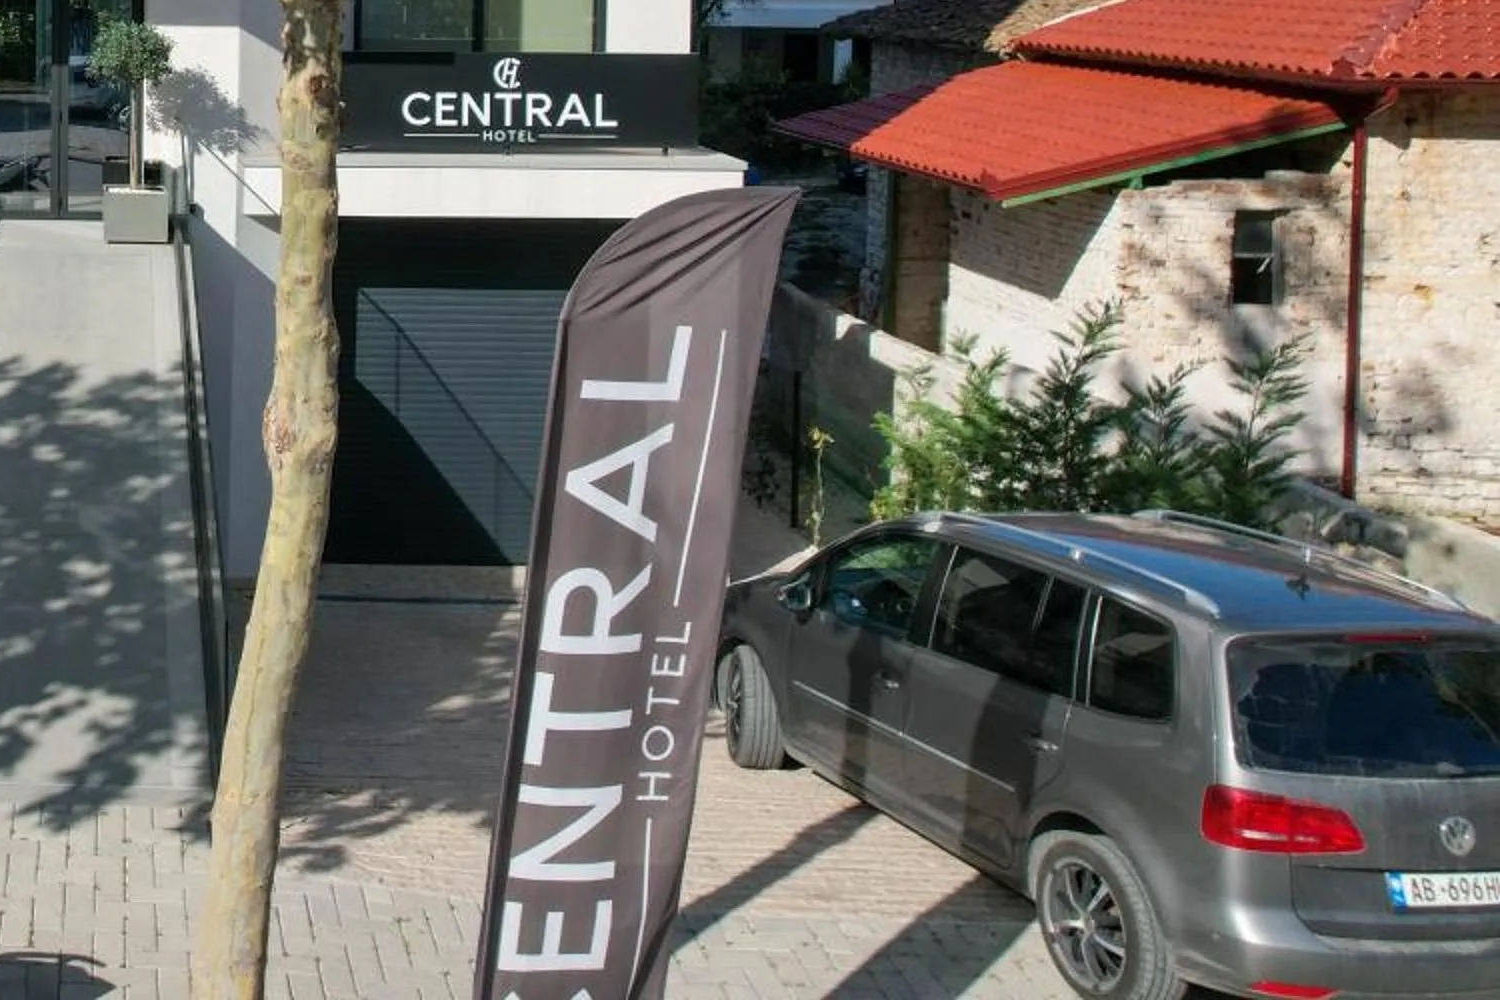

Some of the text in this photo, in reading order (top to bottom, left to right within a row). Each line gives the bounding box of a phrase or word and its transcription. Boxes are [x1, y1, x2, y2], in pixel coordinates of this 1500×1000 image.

[401, 92, 619, 127] CENTRAL
[483, 129, 537, 143] HOTEL
[496, 325, 693, 1000] ENTRAL
[636, 621, 692, 801] HOTEL
